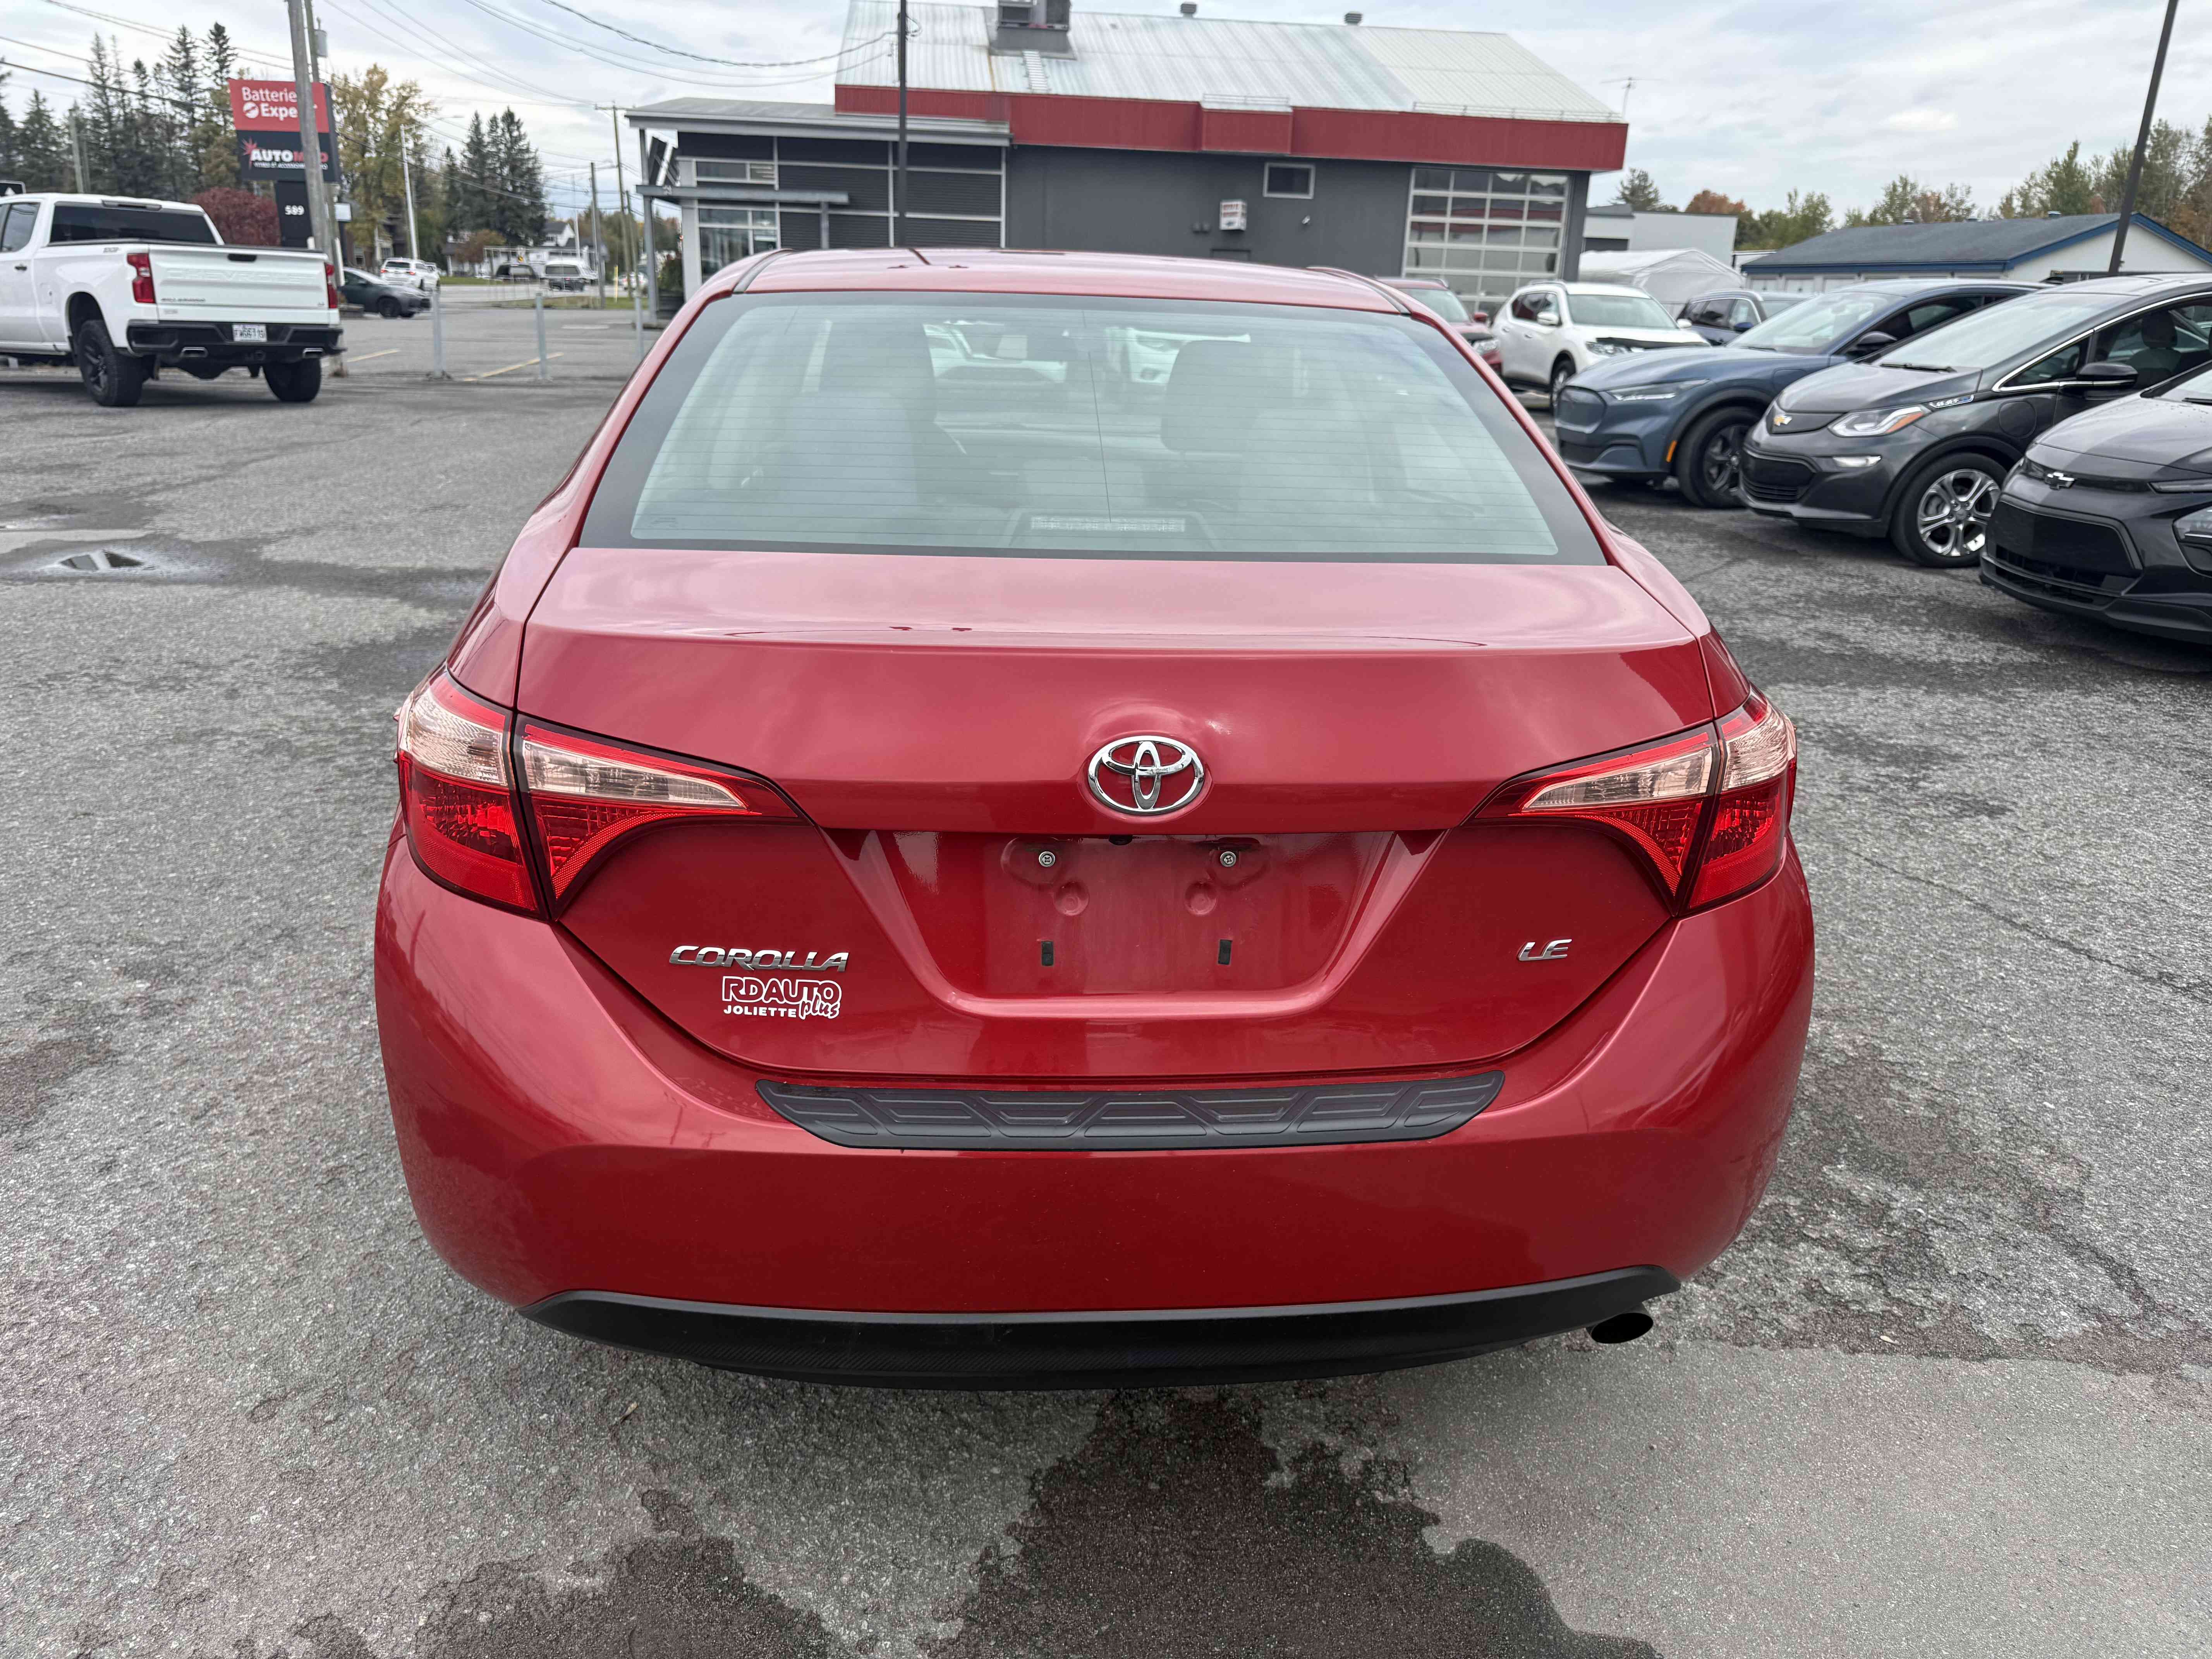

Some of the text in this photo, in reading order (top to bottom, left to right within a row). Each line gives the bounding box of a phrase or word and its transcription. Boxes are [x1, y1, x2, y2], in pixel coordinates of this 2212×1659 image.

[260, 103, 318, 121] Expe
[669, 945, 848, 972] COROLLA
[1518, 939, 1572, 961] LE
[723, 1005, 797, 1018] JOLIETTE
[799, 993, 840, 1020] plus
